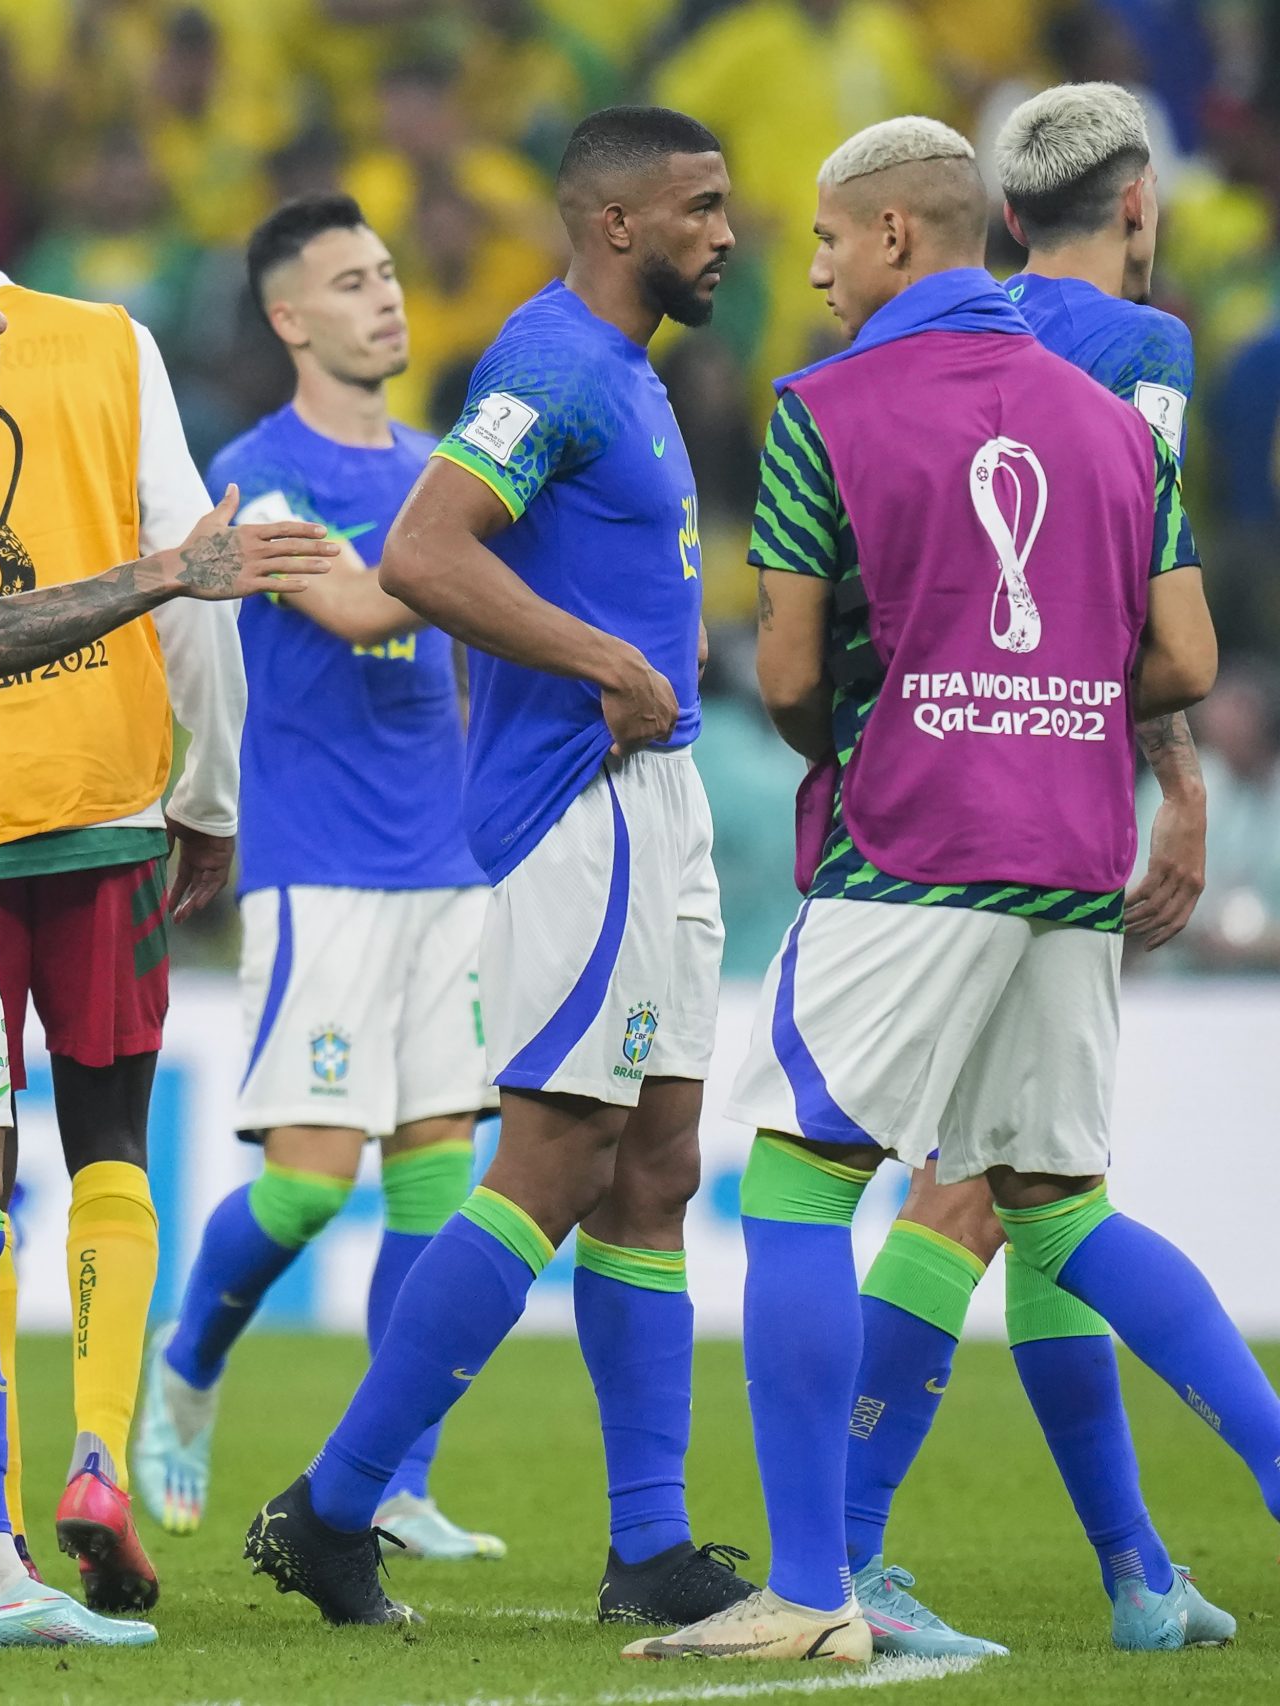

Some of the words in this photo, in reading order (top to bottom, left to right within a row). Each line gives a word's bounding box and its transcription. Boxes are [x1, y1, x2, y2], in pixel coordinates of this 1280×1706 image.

[901, 672, 969, 698] FIFA
[972, 672, 1067, 701] WORLD
[1069, 679, 1122, 706] CUP
[913, 702, 1106, 741] Qatar2022
[612, 1064, 643, 1080] BRASIL
[79, 1249, 97, 1360] CAMEROUN
